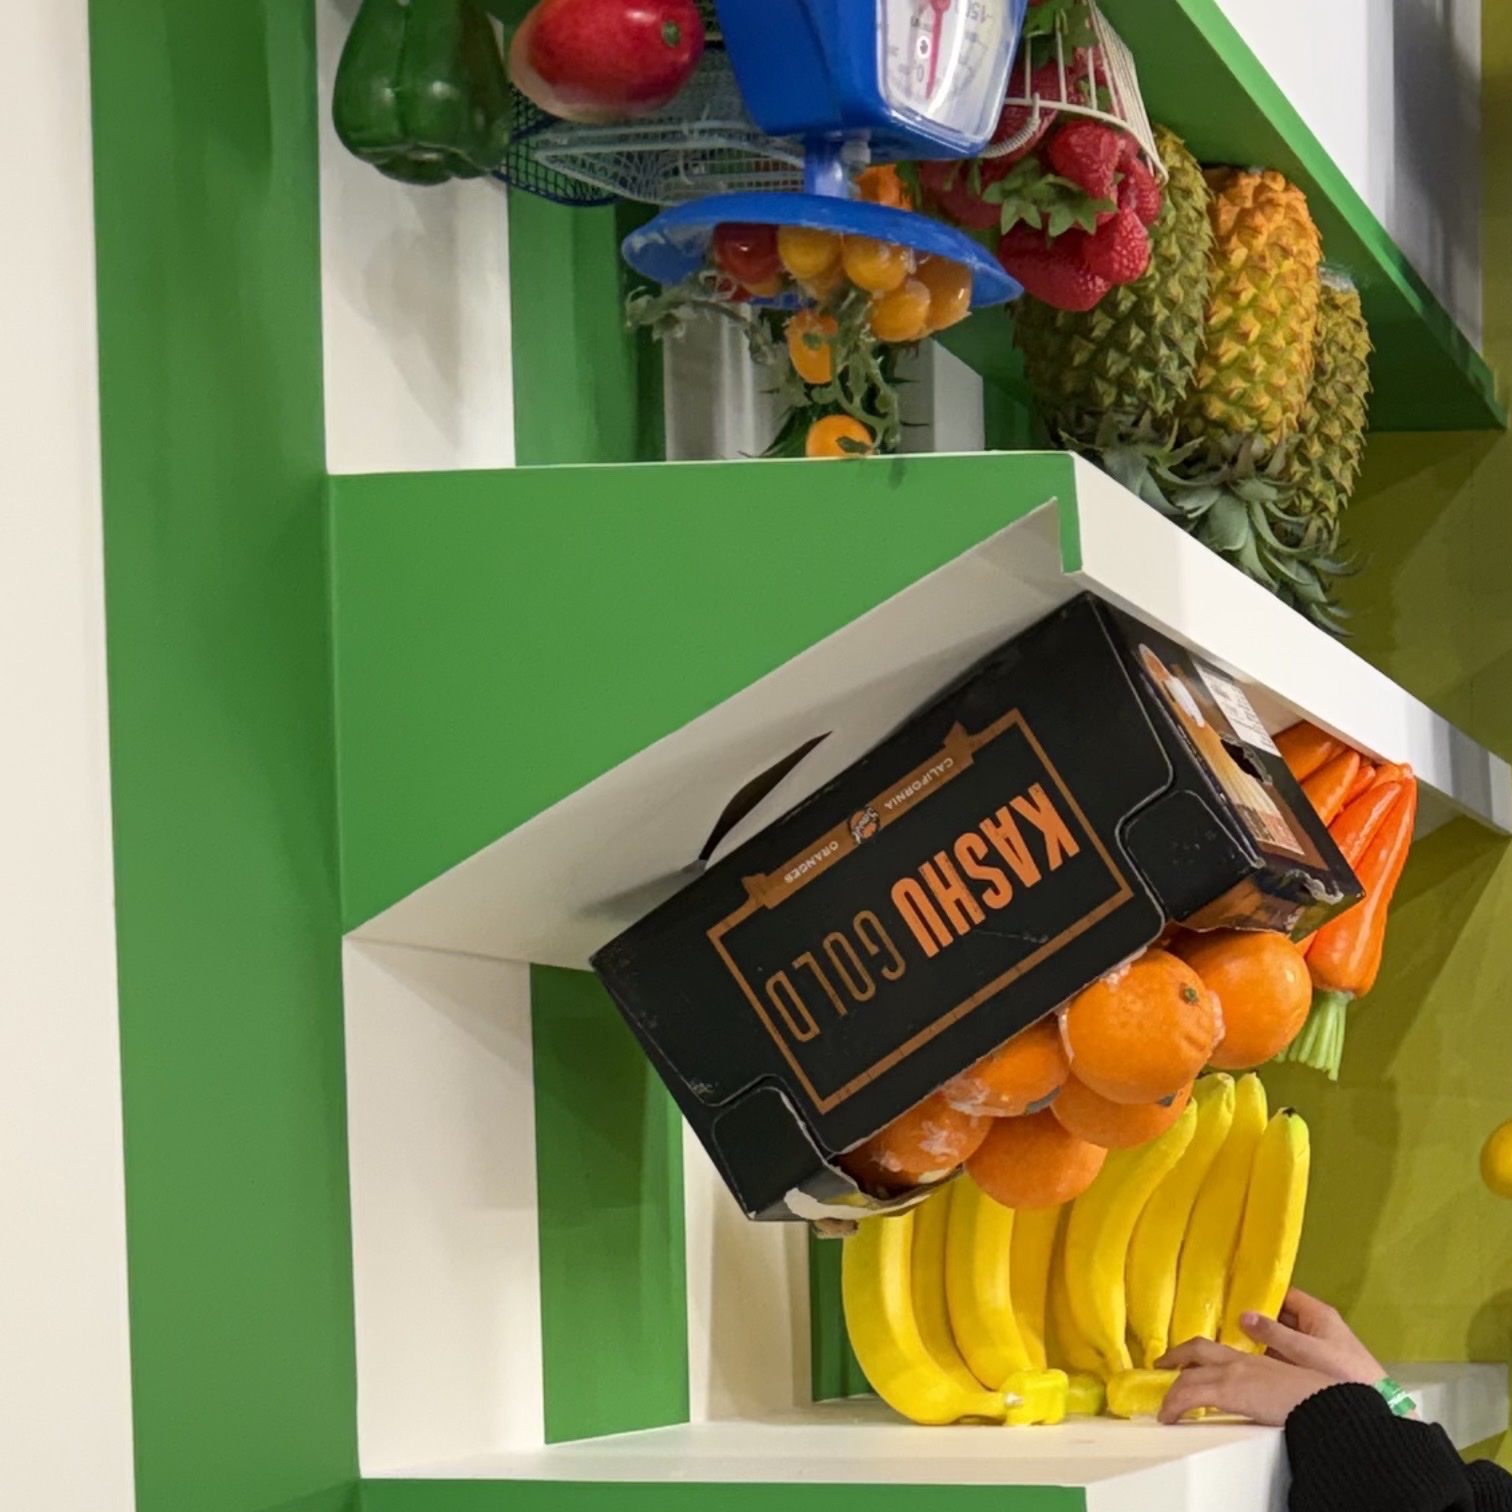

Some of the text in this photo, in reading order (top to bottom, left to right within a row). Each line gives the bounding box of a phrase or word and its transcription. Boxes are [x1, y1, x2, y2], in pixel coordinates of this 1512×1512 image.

[884, 757, 955, 810] CALIFORNIA
[784, 841, 839, 884] ORANGES
[891, 782, 1080, 958] KASHU
[765, 910, 906, 1042] GOLD
